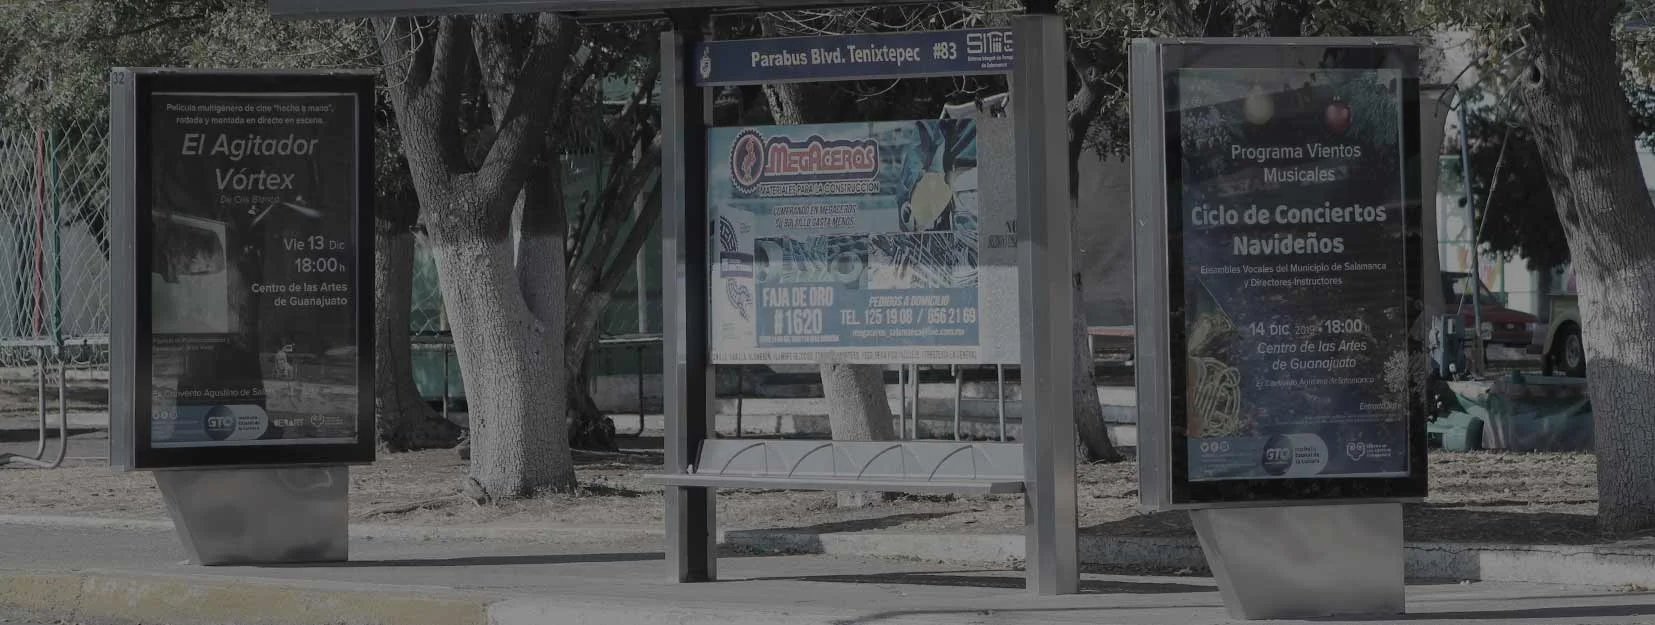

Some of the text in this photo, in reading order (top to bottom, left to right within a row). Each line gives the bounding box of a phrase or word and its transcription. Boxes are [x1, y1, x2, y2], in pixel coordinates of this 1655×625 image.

[751, 41, 957, 68] Parabus Blvd. Tenixtepec #83
[181, 132, 318, 161] El Agitador
[1231, 143, 1362, 163] Programa Vientos
[214, 167, 295, 191] Vórtex
[1263, 166, 1337, 183] Musicales
[1191, 201, 1388, 225] Ciclo de Conciertos
[283, 235, 345, 250] Vie 13 Dic
[1232, 231, 1345, 256] Navideños
[295, 257, 338, 273] 18:00
[1242, 264, 1274, 274] Vocales
[1276, 263, 1289, 274] del
[1291, 263, 1330, 275] Municipio
[1331, 262, 1343, 272] de
[1344, 261, 1388, 273] Salamanca
[251, 282, 348, 293] Centro de las Artes
[1243, 279, 1250, 289] y
[274, 296, 348, 308] de Guanajuato
[762, 286, 834, 307] FAJA DE ORO
[773, 308, 823, 335] #1620
[864, 309, 883, 325] 125
[885, 309, 899, 324] 19
[1249, 322, 1266, 337] 14
[1270, 324, 1290, 336] DIC
[1324, 319, 1363, 335] 18:00
[1257, 339, 1368, 355] Centro de las Artes
[1272, 356, 1357, 371] de Guanajuato
[207, 416, 234, 428] GTO
[1265, 448, 1290, 461] GTO
